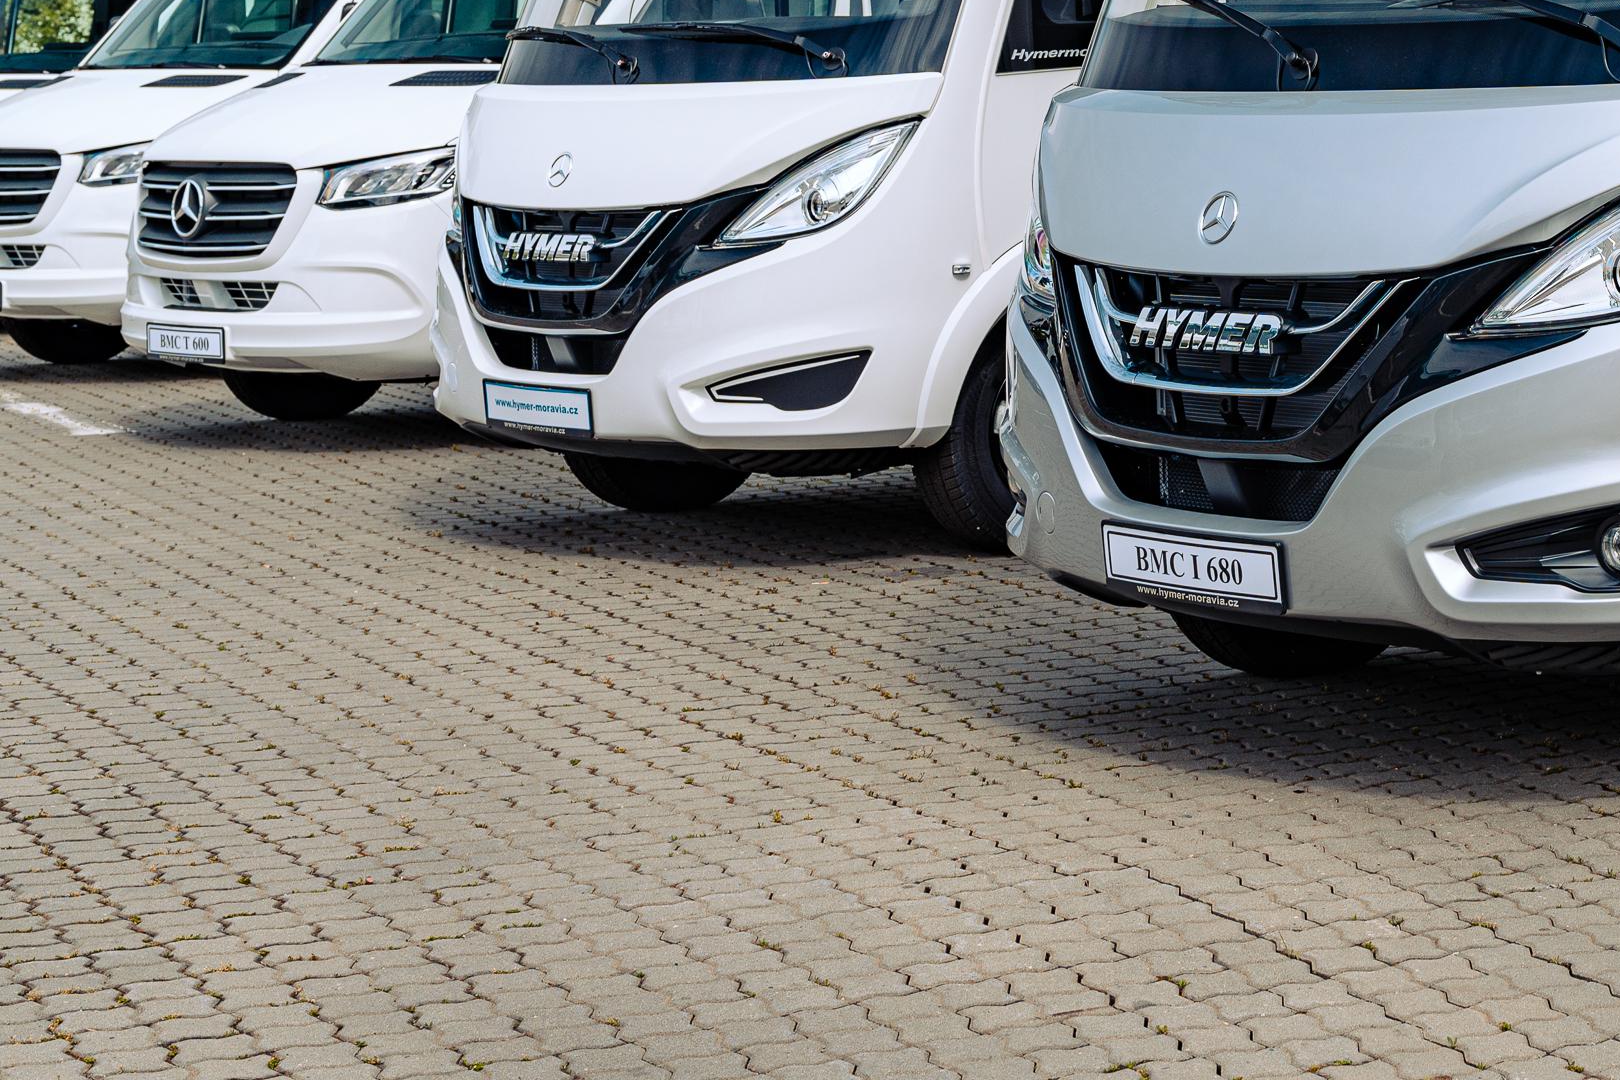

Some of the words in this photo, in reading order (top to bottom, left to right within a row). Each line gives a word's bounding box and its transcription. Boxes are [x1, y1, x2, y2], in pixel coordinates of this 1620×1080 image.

[1011, 48, 1088, 62] Hymermo
[502, 232, 596, 262] HYMER
[160, 334, 181, 349] BMC
[183, 336, 190, 350] T
[192, 337, 209, 351] 600
[1129, 306, 1282, 355] HYMER
[494, 398, 579, 415] www.hymer-moravia.cz
[1134, 545, 1185, 578] BMC
[1190, 554, 1200, 580] I
[1206, 556, 1243, 586] 680
[1136, 584, 1240, 608] www.hymer-moravia.cz
